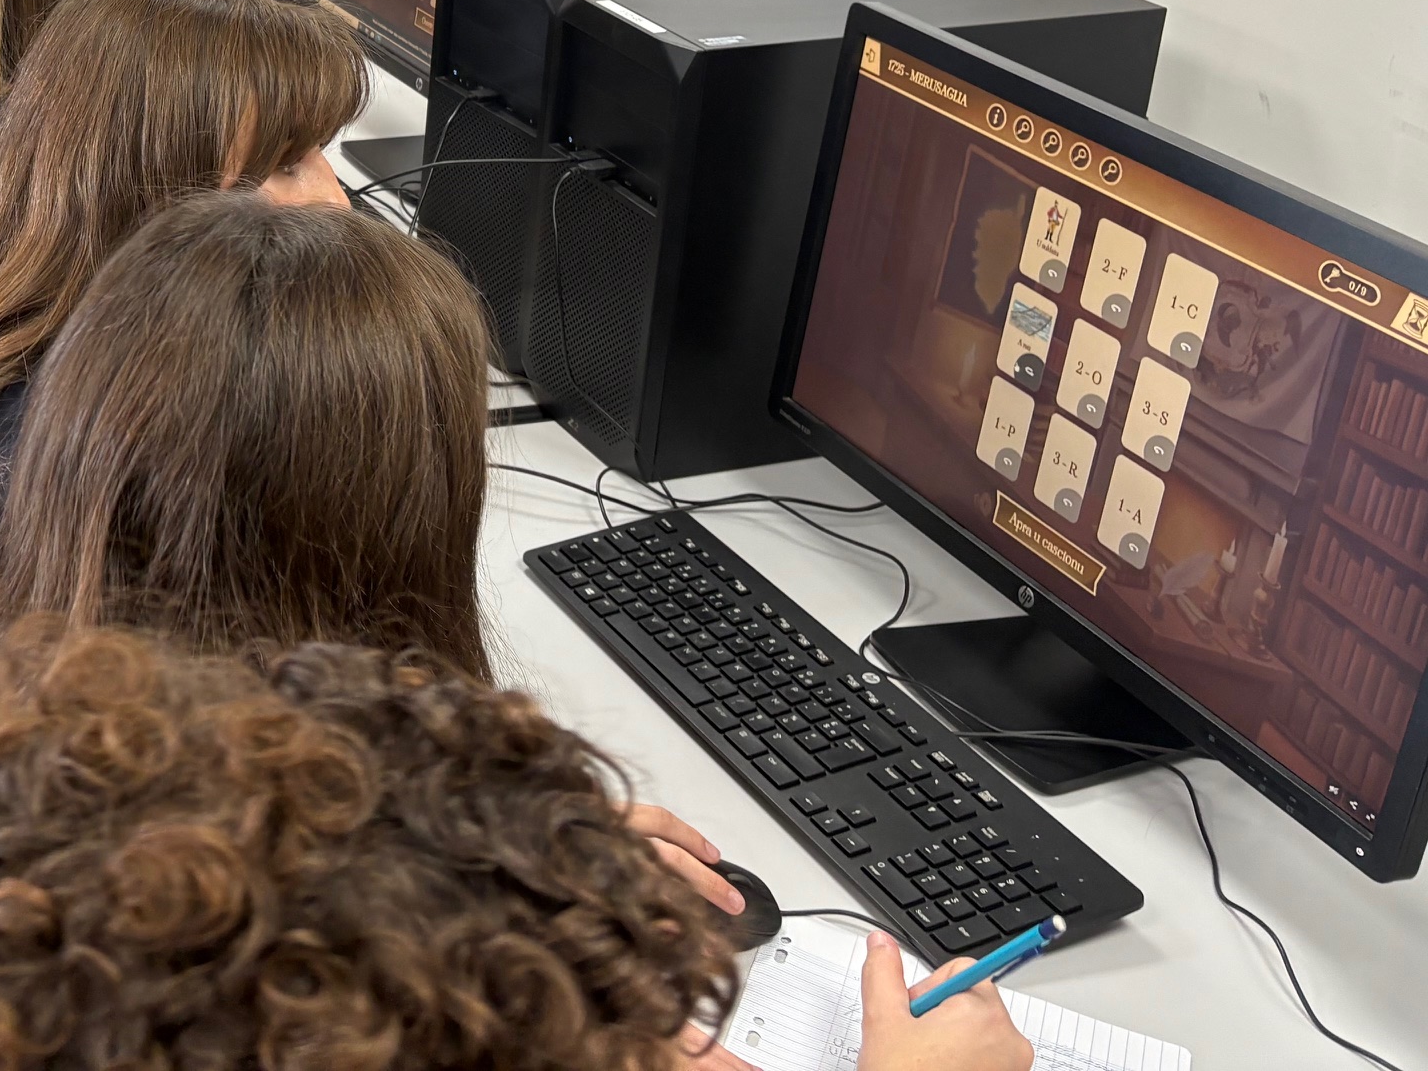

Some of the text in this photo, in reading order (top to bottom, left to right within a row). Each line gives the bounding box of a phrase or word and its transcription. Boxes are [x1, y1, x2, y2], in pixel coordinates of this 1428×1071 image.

[887, 59, 905, 76] 1725
[909, 69, 968, 107] MERUSAGLIA
[1349, 281, 1367, 297] 0/9
[1008, 511, 1084, 575] Apra u cascionu
